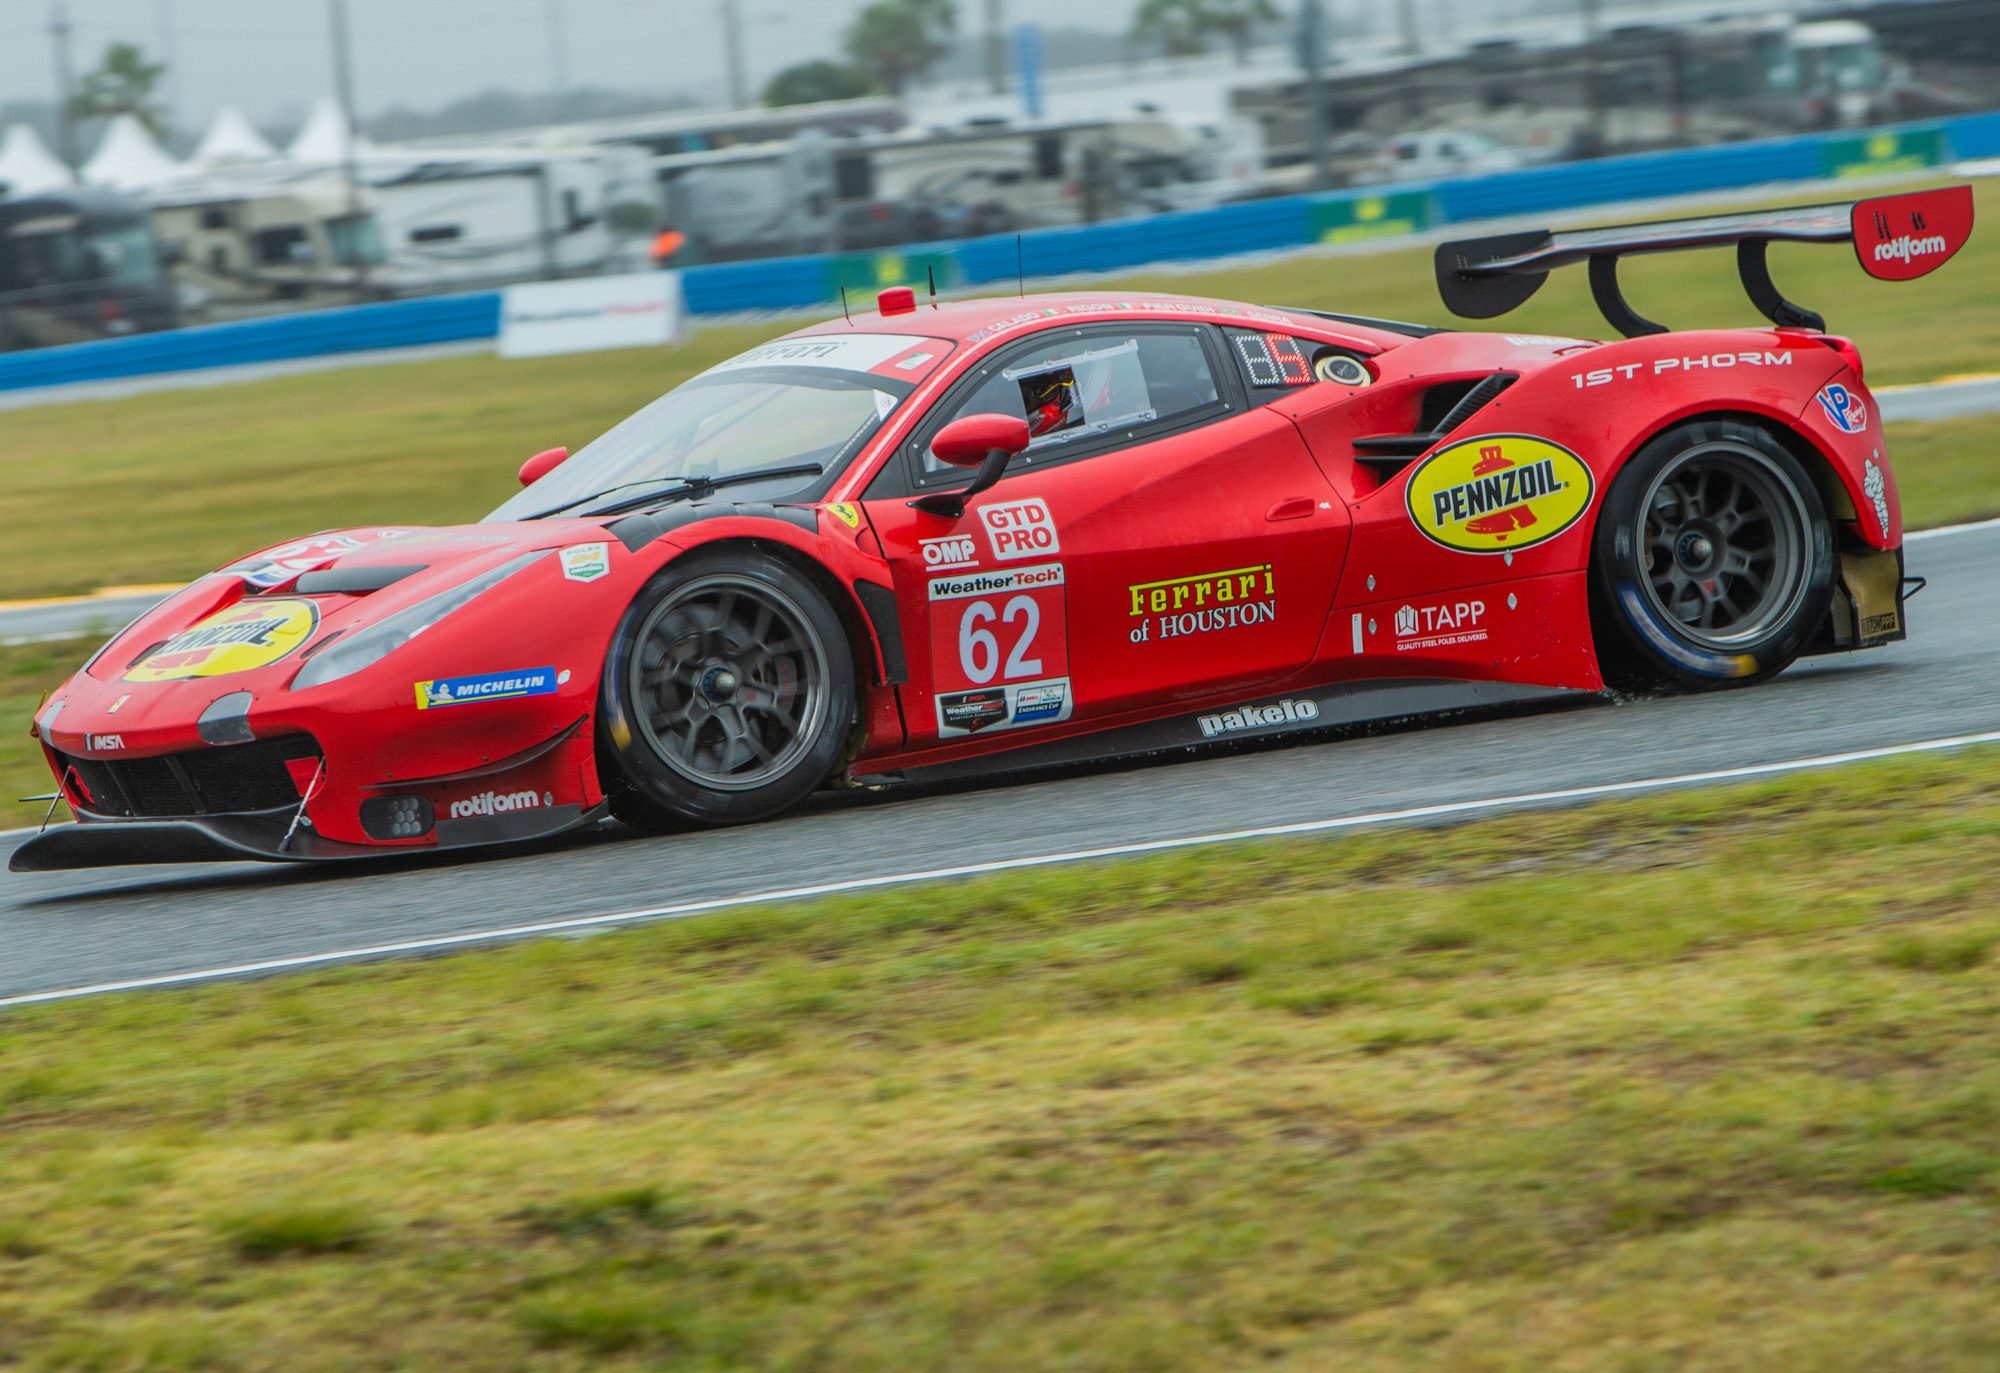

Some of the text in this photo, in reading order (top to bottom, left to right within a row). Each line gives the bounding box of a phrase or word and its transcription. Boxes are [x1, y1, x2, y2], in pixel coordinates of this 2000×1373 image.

[1874, 235, 1946, 264] rotiform
[1571, 351, 1793, 389] 1ST PHORM
[1817, 384, 1850, 431] VP
[1432, 458, 1563, 528] PENNZOIL
[986, 504, 1045, 528] GTD
[922, 539, 976, 565] OMP
[994, 527, 1053, 553] PRO
[934, 568, 1060, 596] WeatherTech
[1129, 564, 1275, 616] Ferrari
[1129, 599, 1276, 644] of HOUSTON
[1420, 600, 1486, 631] TAPP
[958, 594, 1043, 685] 62
[1397, 641, 1422, 651] QUALITY
[1422, 639, 1438, 648] STEEL
[456, 676, 545, 697] MICHELIN
[1199, 700, 1319, 736] pakelo
[450, 790, 539, 818] rotiform
